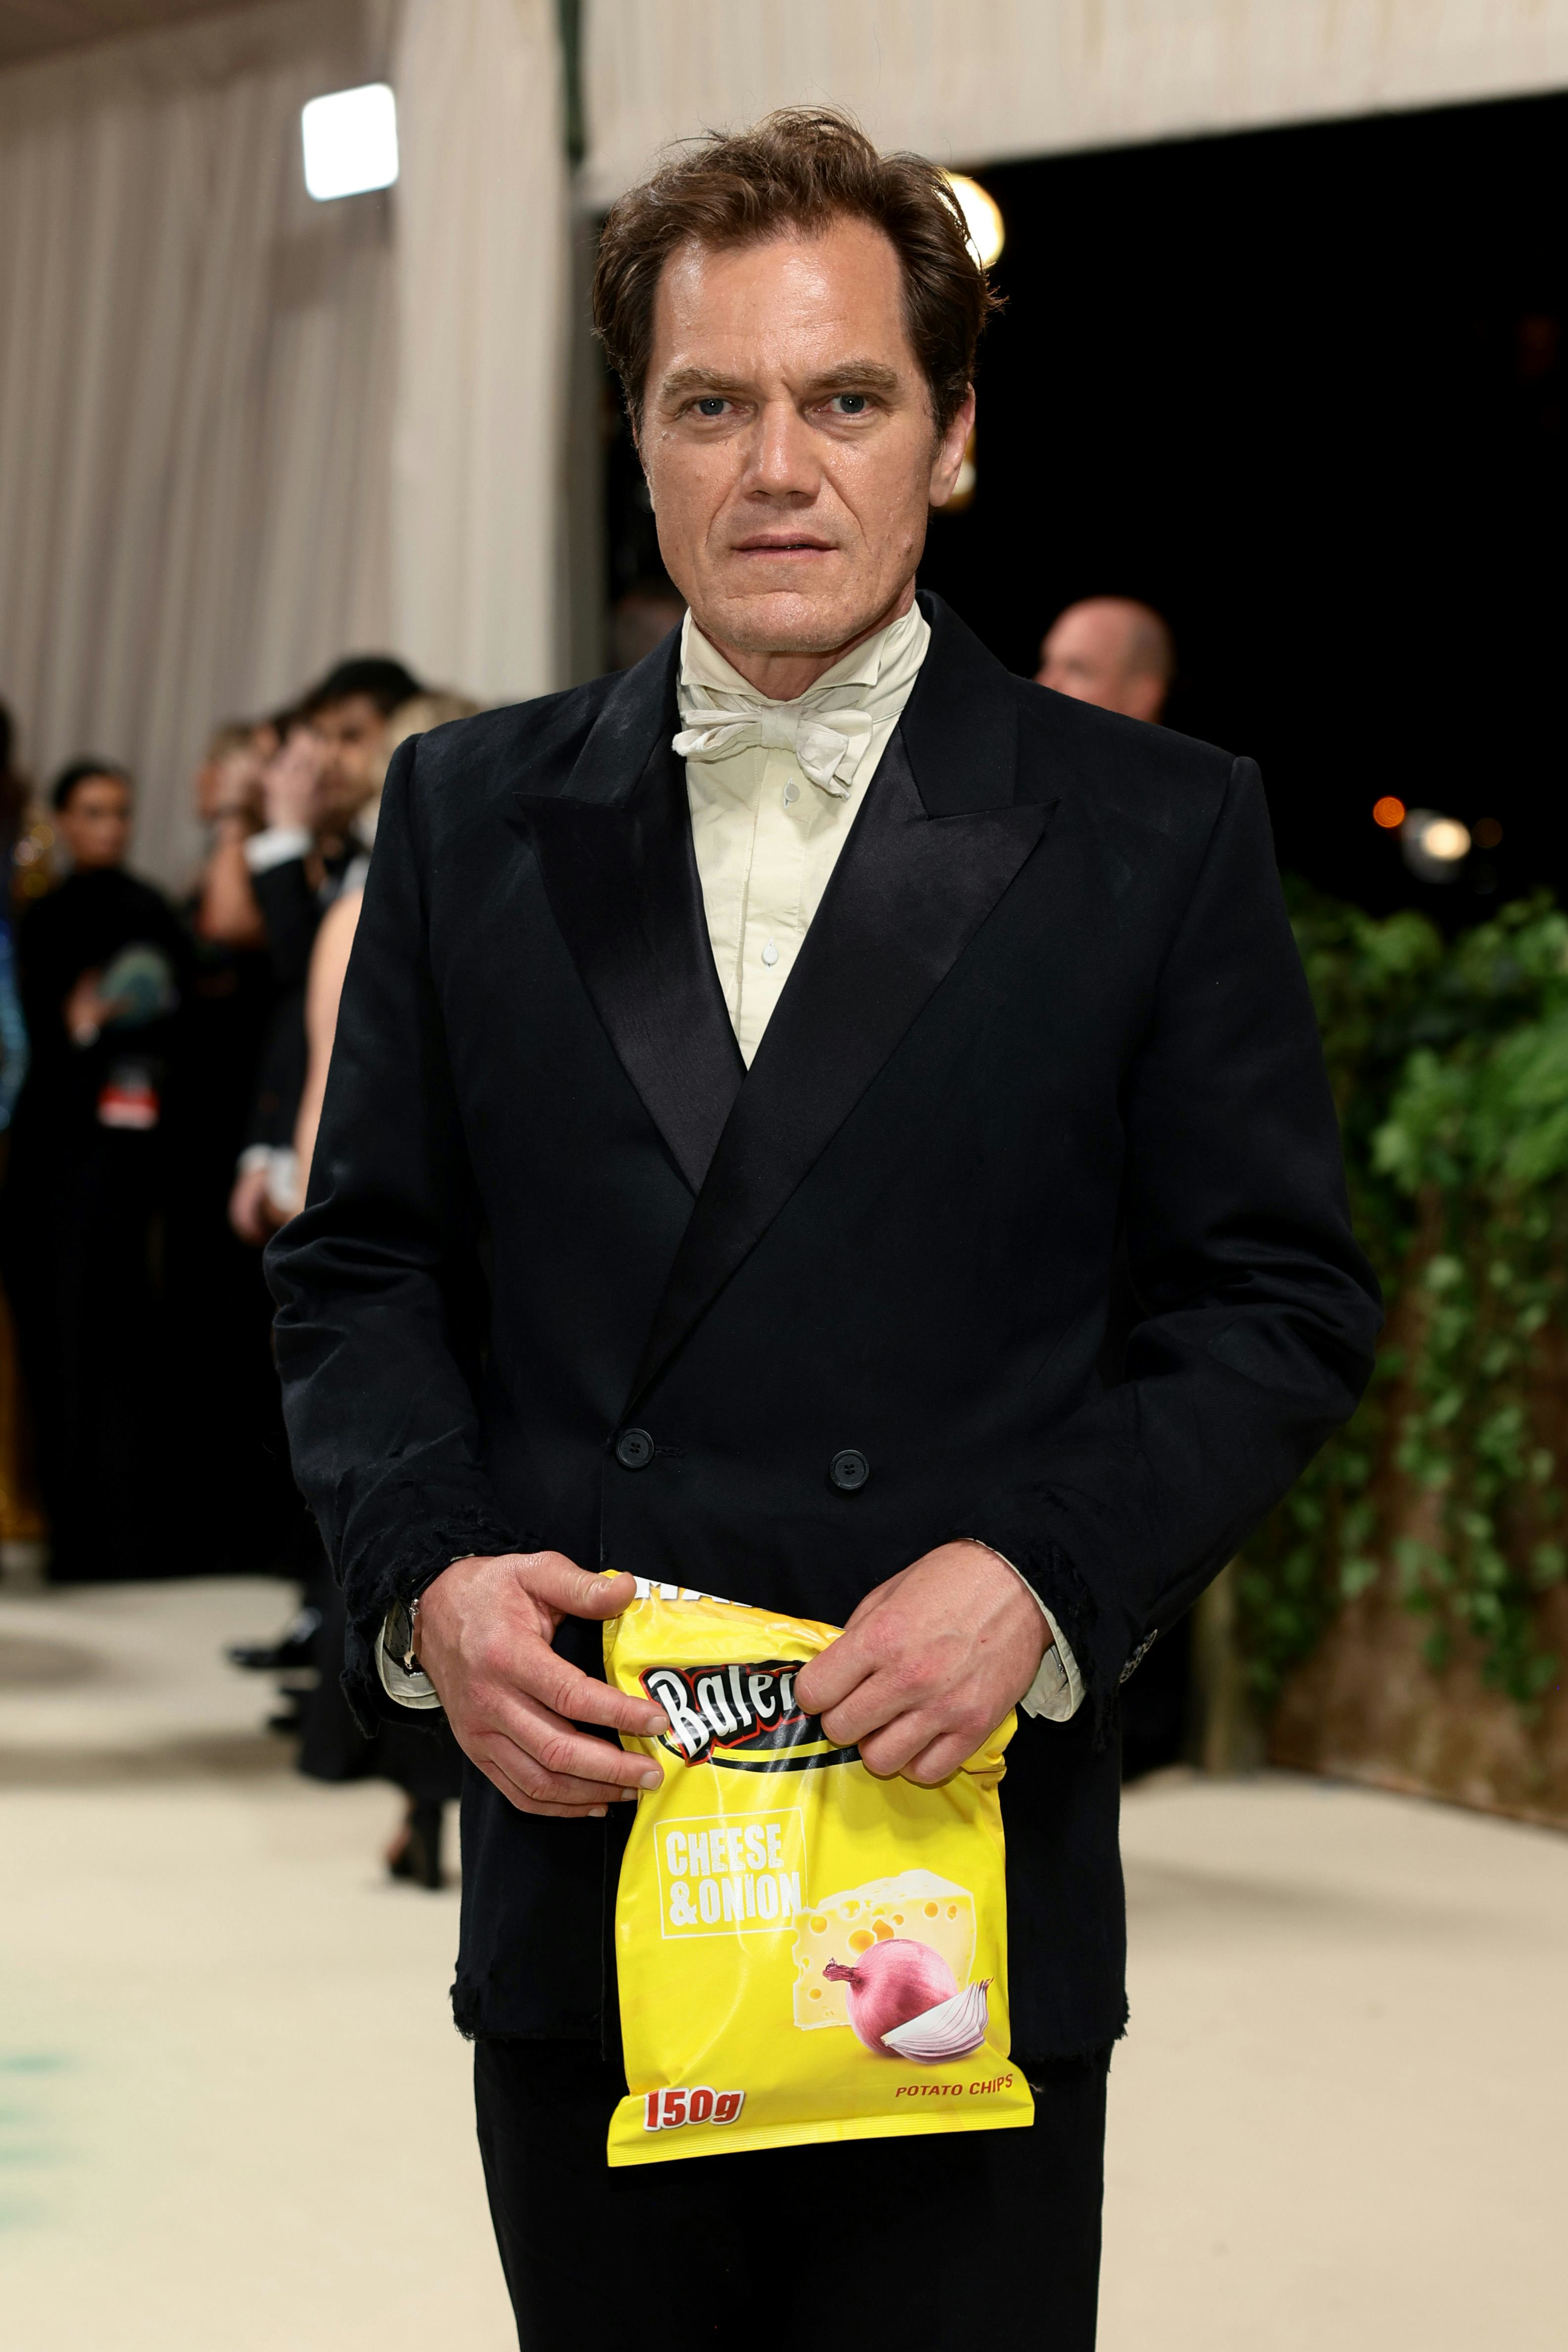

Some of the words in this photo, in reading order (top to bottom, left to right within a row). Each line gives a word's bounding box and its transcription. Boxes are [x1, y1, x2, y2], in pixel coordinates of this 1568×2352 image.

[666, 1823, 784, 1877] CHEESE
[644, 2085, 745, 2131] 150g
[896, 2084, 963, 2097] POTATO
[969, 2073, 1013, 2095] CHIPS
